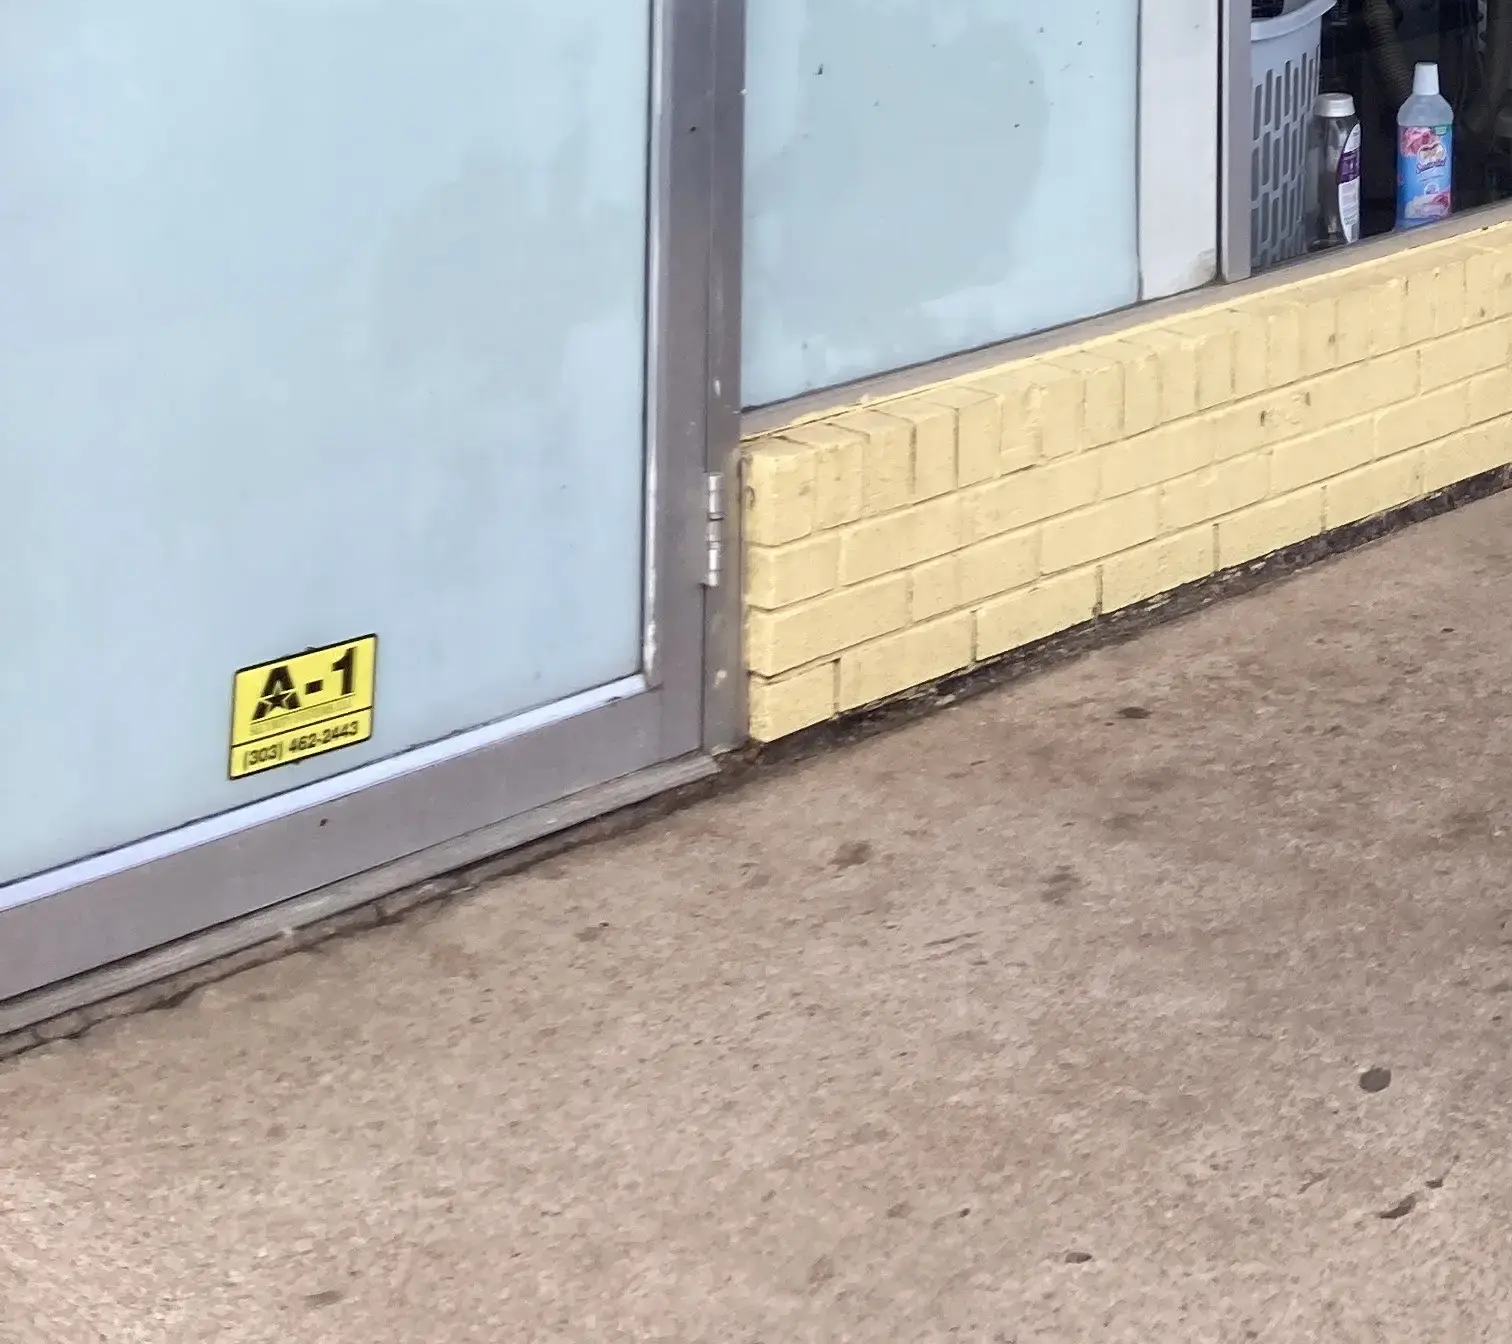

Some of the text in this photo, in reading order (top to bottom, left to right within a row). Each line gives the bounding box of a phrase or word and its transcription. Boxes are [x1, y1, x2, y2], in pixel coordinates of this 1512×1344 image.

[251, 646, 358, 721] A-1
[243, 720, 359, 771] (303) 462-2443
